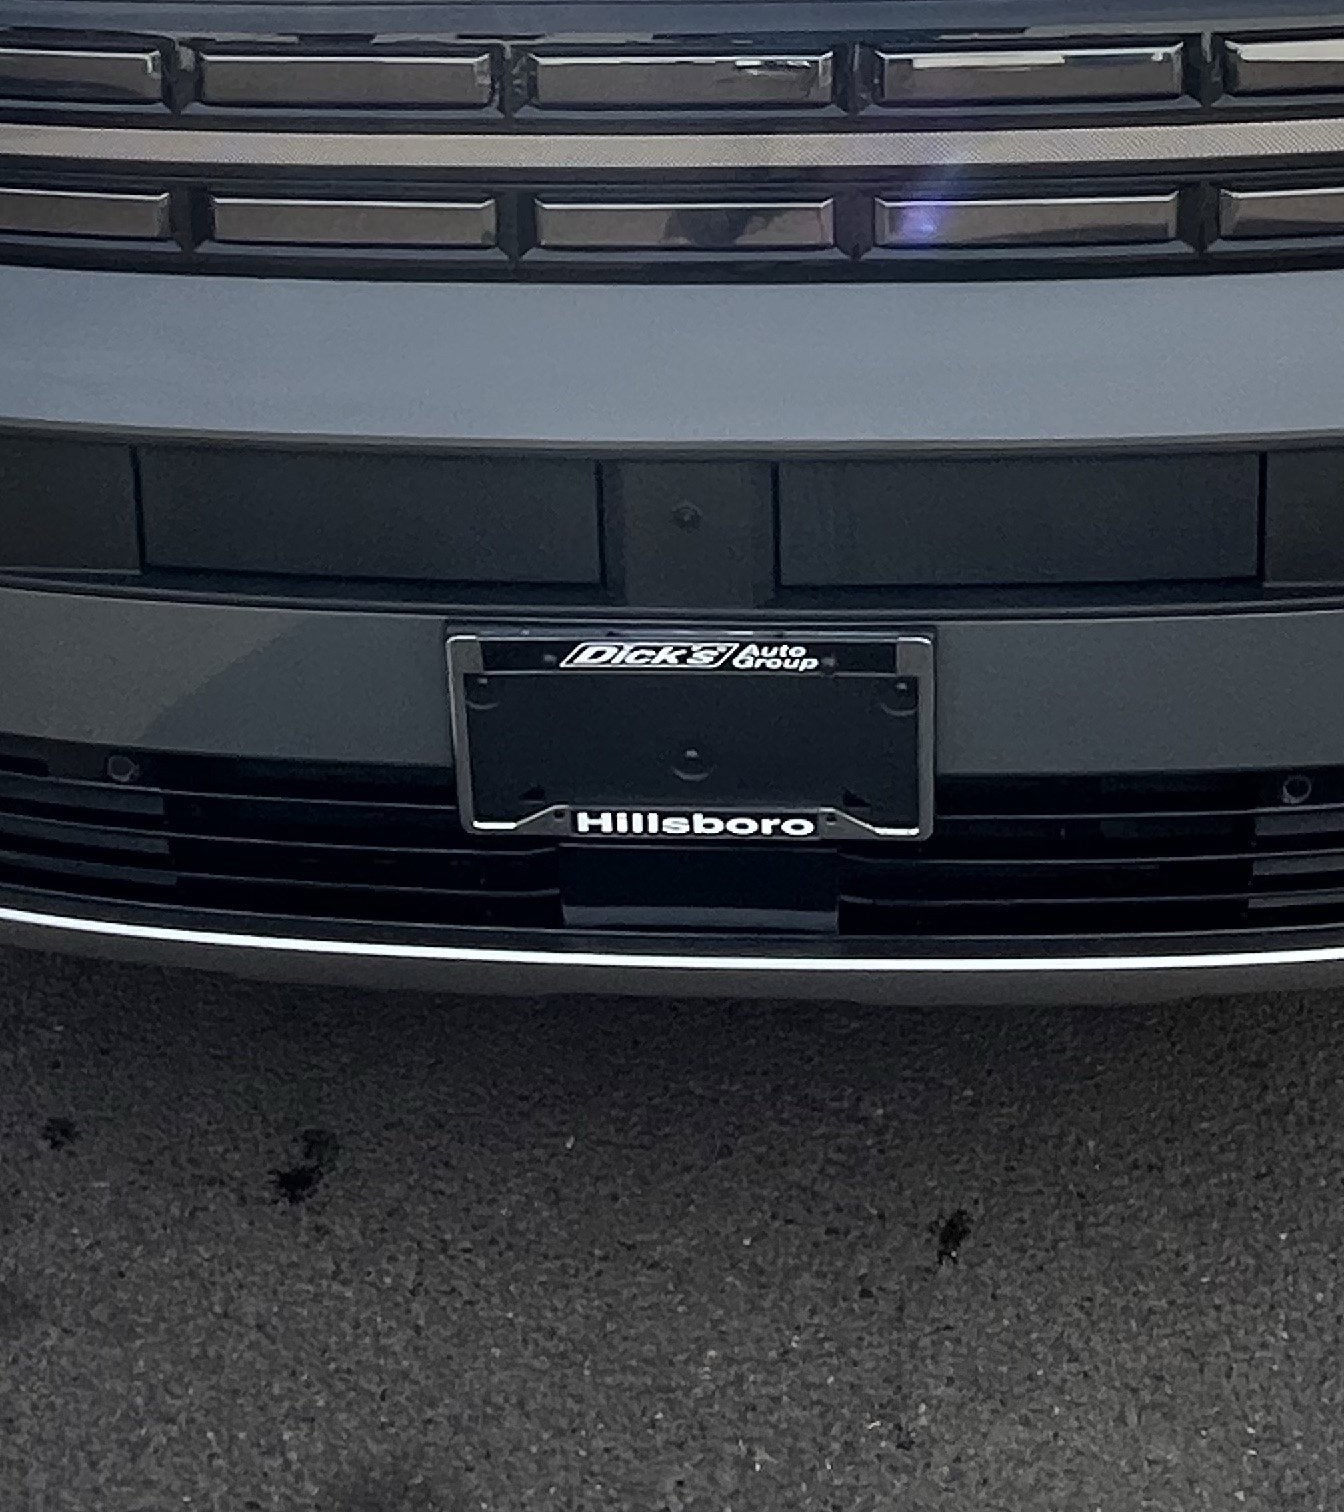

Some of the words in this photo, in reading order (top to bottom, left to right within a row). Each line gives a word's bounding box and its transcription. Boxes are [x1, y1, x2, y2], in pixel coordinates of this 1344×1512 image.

[745, 643, 807, 658] Auto
[733, 654, 819, 672] Group
[577, 811, 815, 836] Hillsboro
